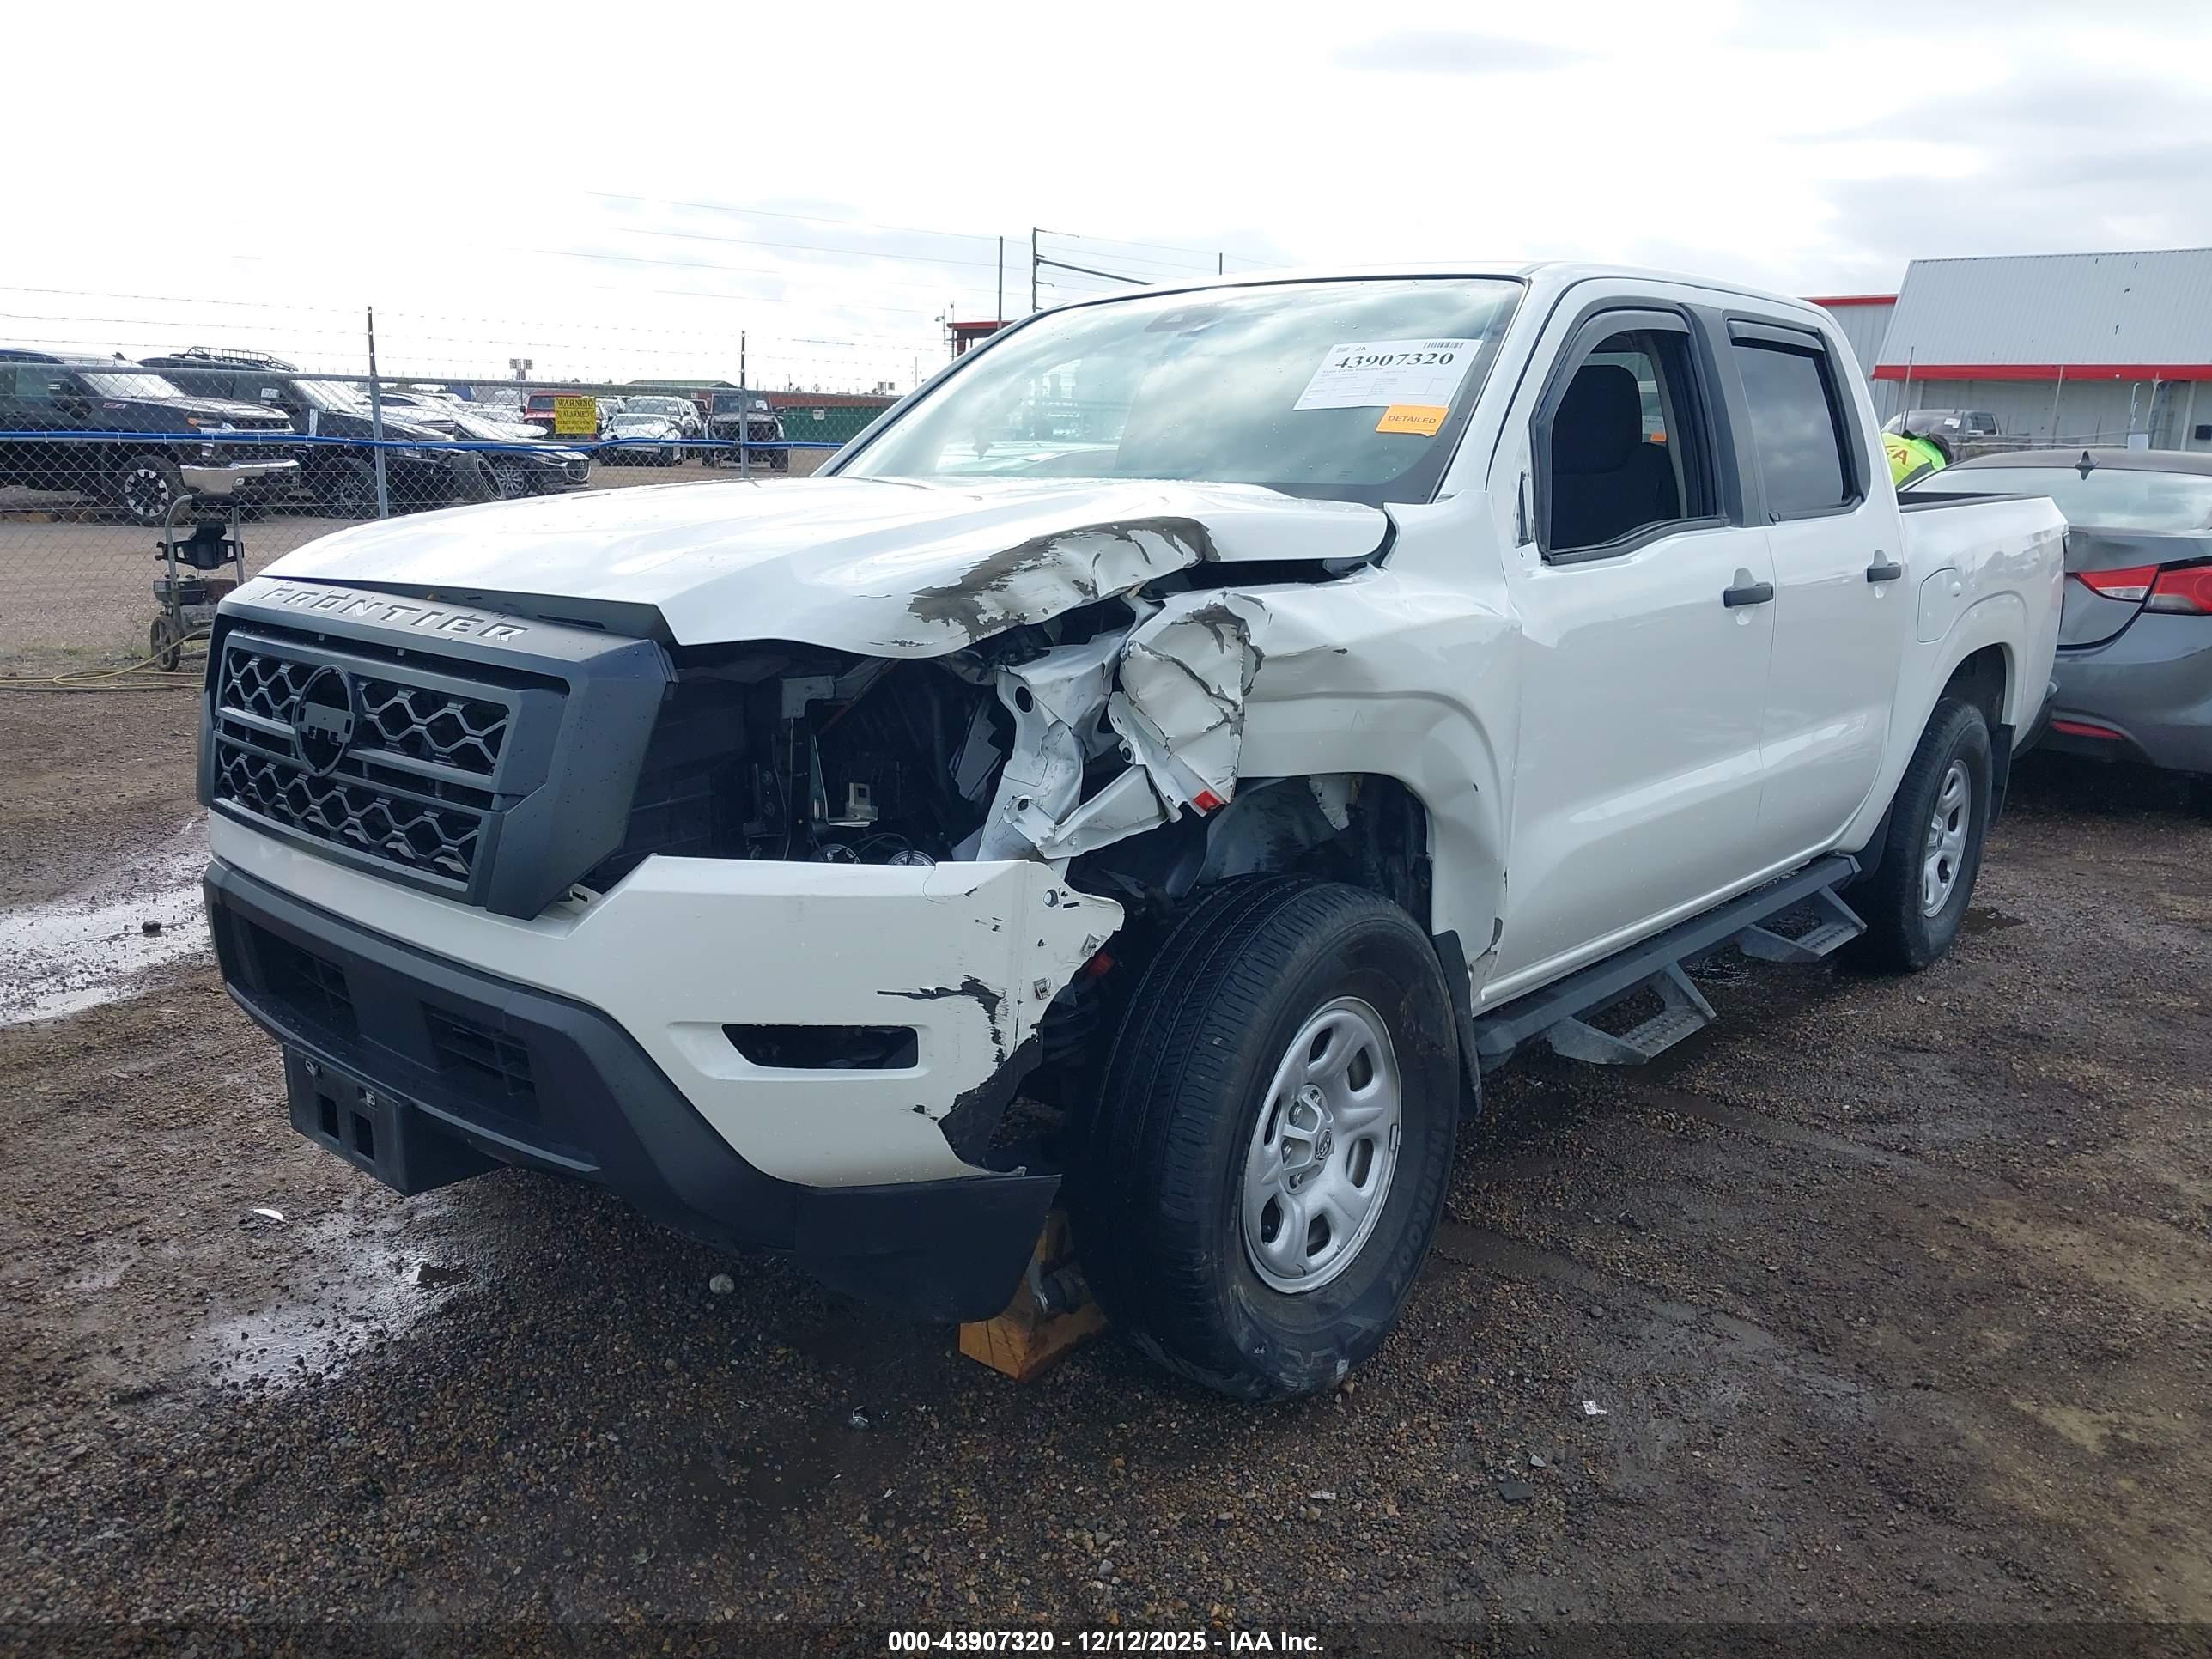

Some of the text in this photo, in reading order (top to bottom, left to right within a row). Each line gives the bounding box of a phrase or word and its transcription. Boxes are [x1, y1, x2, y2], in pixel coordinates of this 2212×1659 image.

[1335, 352, 1455, 368] 43907320
[558, 398, 593, 407] WARNING
[1388, 415, 1437, 424] DETAILED
[260, 586, 530, 642] FRONTIER
